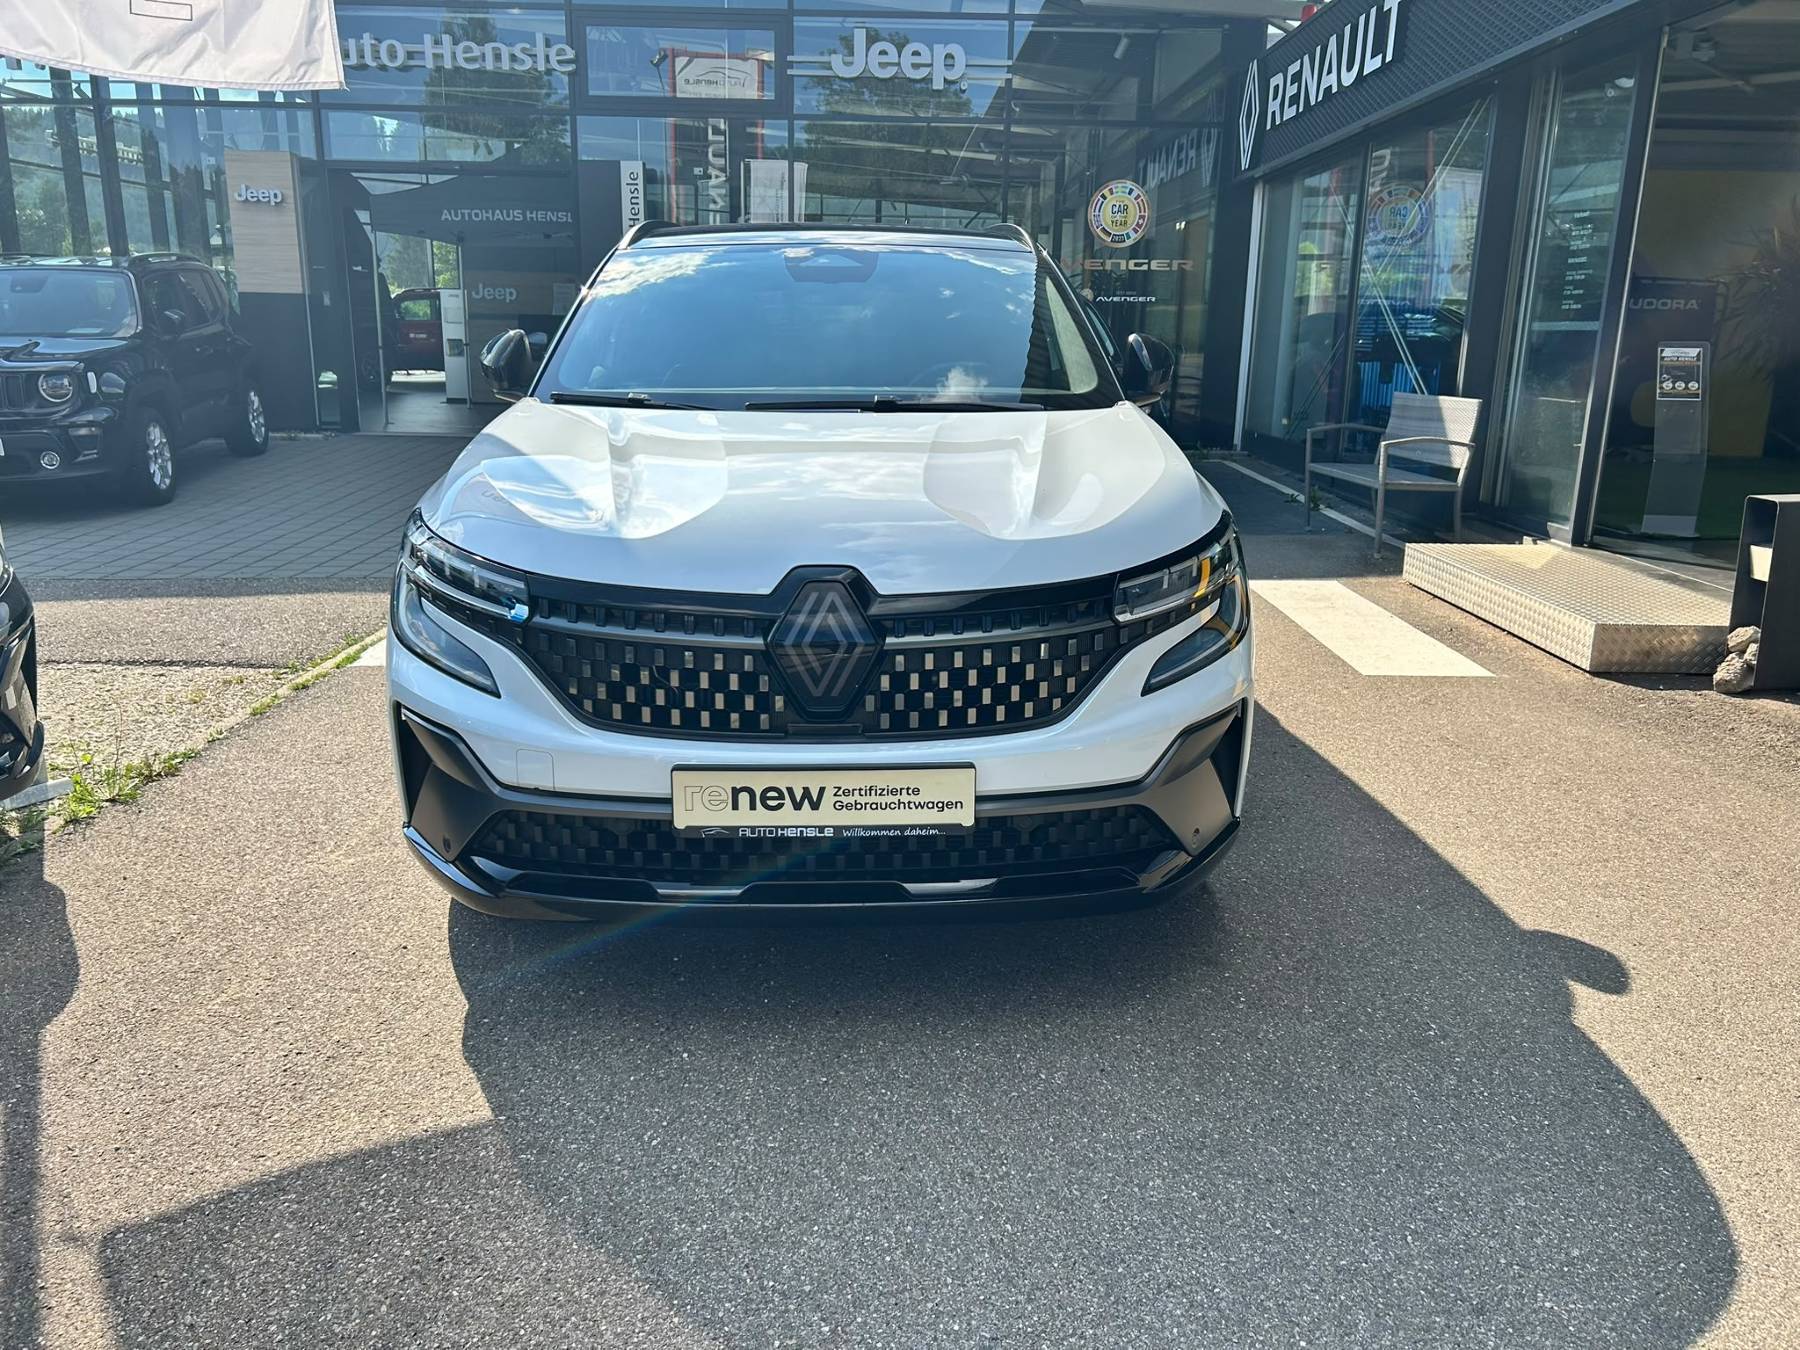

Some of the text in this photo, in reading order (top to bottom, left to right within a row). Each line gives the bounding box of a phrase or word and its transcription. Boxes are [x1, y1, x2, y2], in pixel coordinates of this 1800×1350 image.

[342, 31, 577, 72] uto Hensle
[830, 28, 967, 90] Jeep
[1266, 0, 1400, 131] RENAULT
[234, 184, 282, 206] Jeep
[440, 209, 573, 222] AUTOHAUS HENSL
[1111, 203, 1129, 215] CAR
[1111, 219, 1128, 227] YEAR
[1061, 258, 1196, 271] VENGER
[471, 283, 517, 302] Jeep
[832, 785, 921, 797] Zertifizierte
[684, 785, 827, 811] renew
[832, 799, 964, 813] Gebrauchtwagen
[739, 827, 776, 837] AUTO
[842, 827, 901, 837] Willkommen
